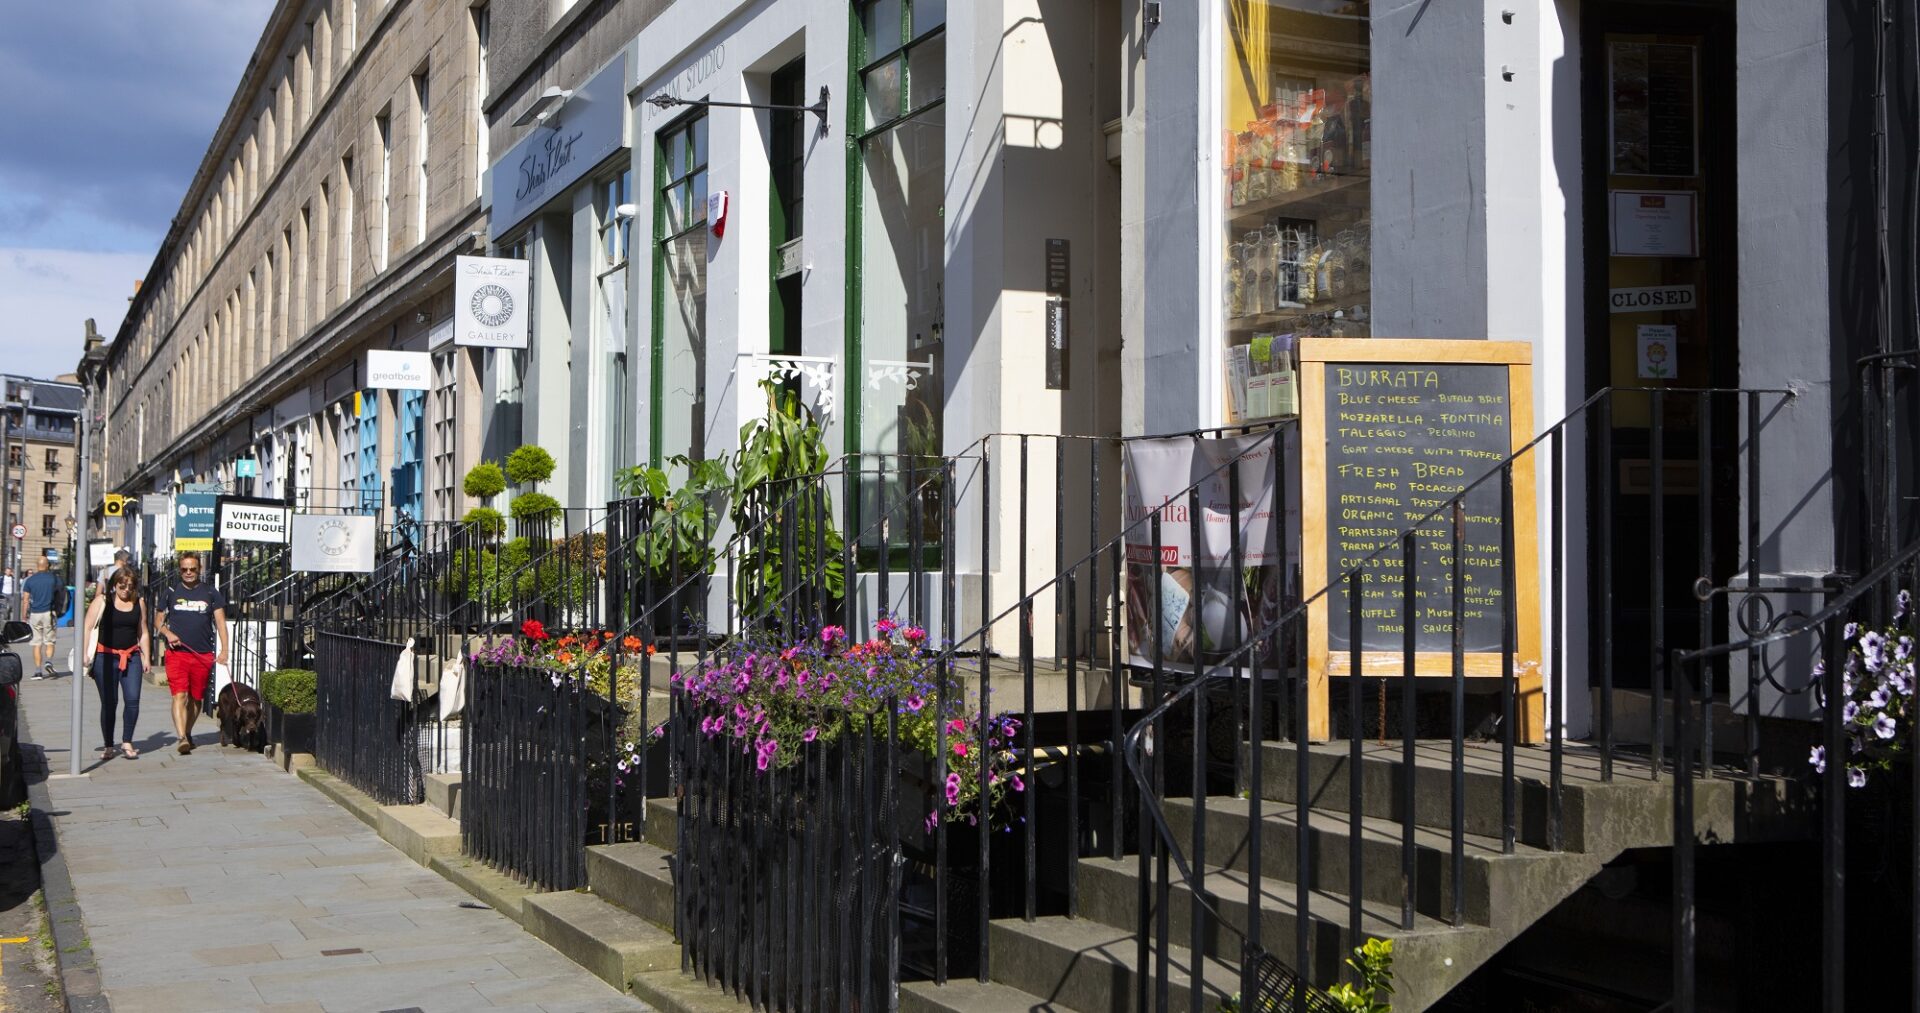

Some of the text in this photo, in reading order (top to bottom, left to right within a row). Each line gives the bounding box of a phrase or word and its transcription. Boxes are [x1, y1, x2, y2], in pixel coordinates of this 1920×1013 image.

[686, 44, 725, 92] STUDIO
[1611, 290, 1692, 308] CLOSED
[467, 330, 516, 341] GALLERY
[372, 371, 421, 383] greatbase
[1337, 369, 1439, 388] BURRATA
[1337, 393, 1503, 405] BLUE CHEESE BUFALO BRIE
[1340, 413, 1503, 425] MOZZARELLA FONTINA
[1339, 428, 1475, 438] TALEGGIO PECORINO
[1342, 445, 1502, 460] GOAT CHEESE WITH TRUFFLE
[1337, 463, 1464, 478] FRESH BREAD
[1374, 482, 1396, 490] AND
[1341, 495, 1401, 506] ARTISANAL
[188, 507, 215, 515] RETTIE
[232, 511, 280, 523] VINTAGE
[1342, 509, 1394, 520] ORGANIC
[226, 521, 285, 533] BOUTIQUE
[1338, 526, 1398, 537] PARMESAN
[1341, 542, 1375, 550] PARMA
[1479, 545, 1500, 553] HAM
[1464, 597, 1495, 605] COFFEE
